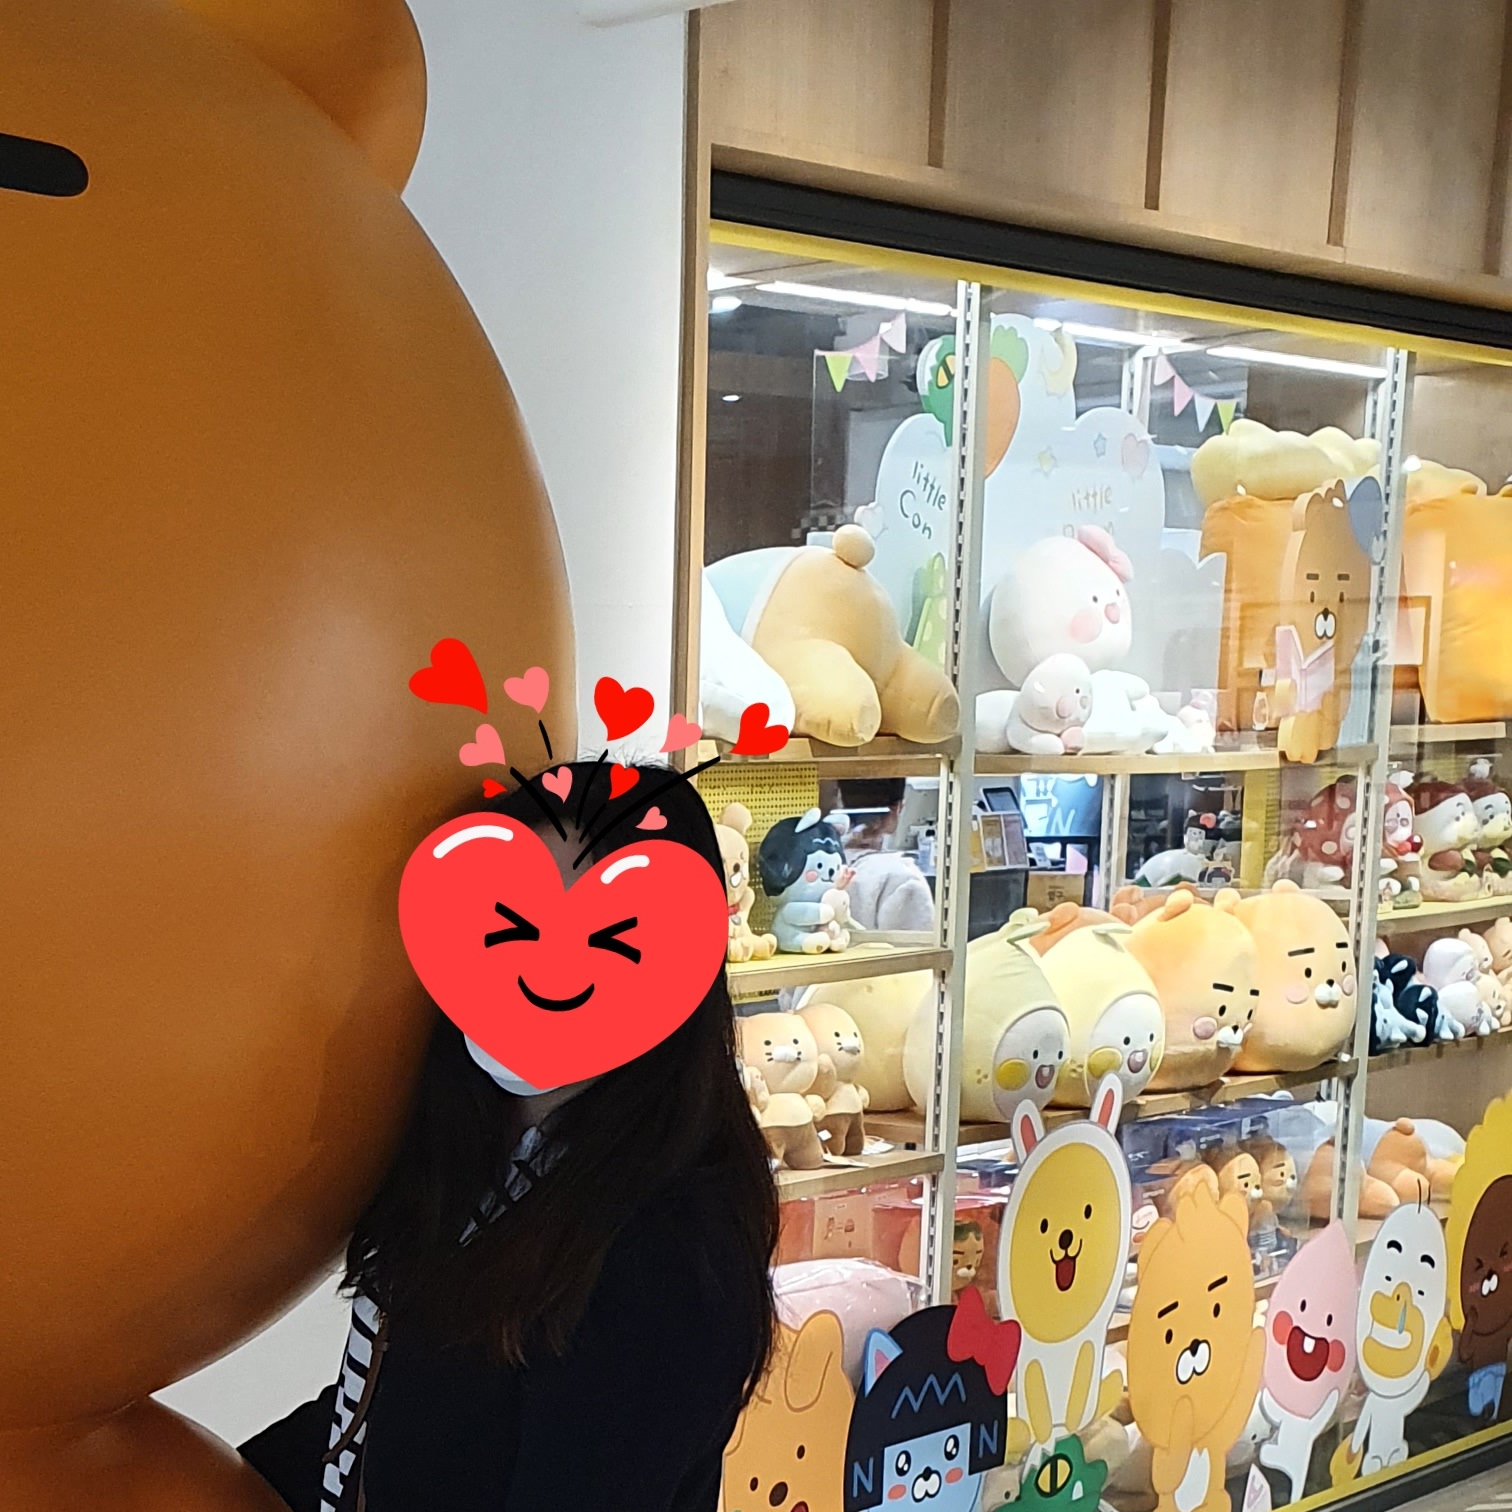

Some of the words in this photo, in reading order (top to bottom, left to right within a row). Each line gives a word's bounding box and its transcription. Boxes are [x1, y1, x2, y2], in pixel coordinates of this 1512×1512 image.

[912, 460, 946, 511] little
[1071, 484, 1113, 514] little
[900, 489, 932, 540] Con
[978, 1419, 999, 1459] N
[852, 1457, 874, 1498] N
